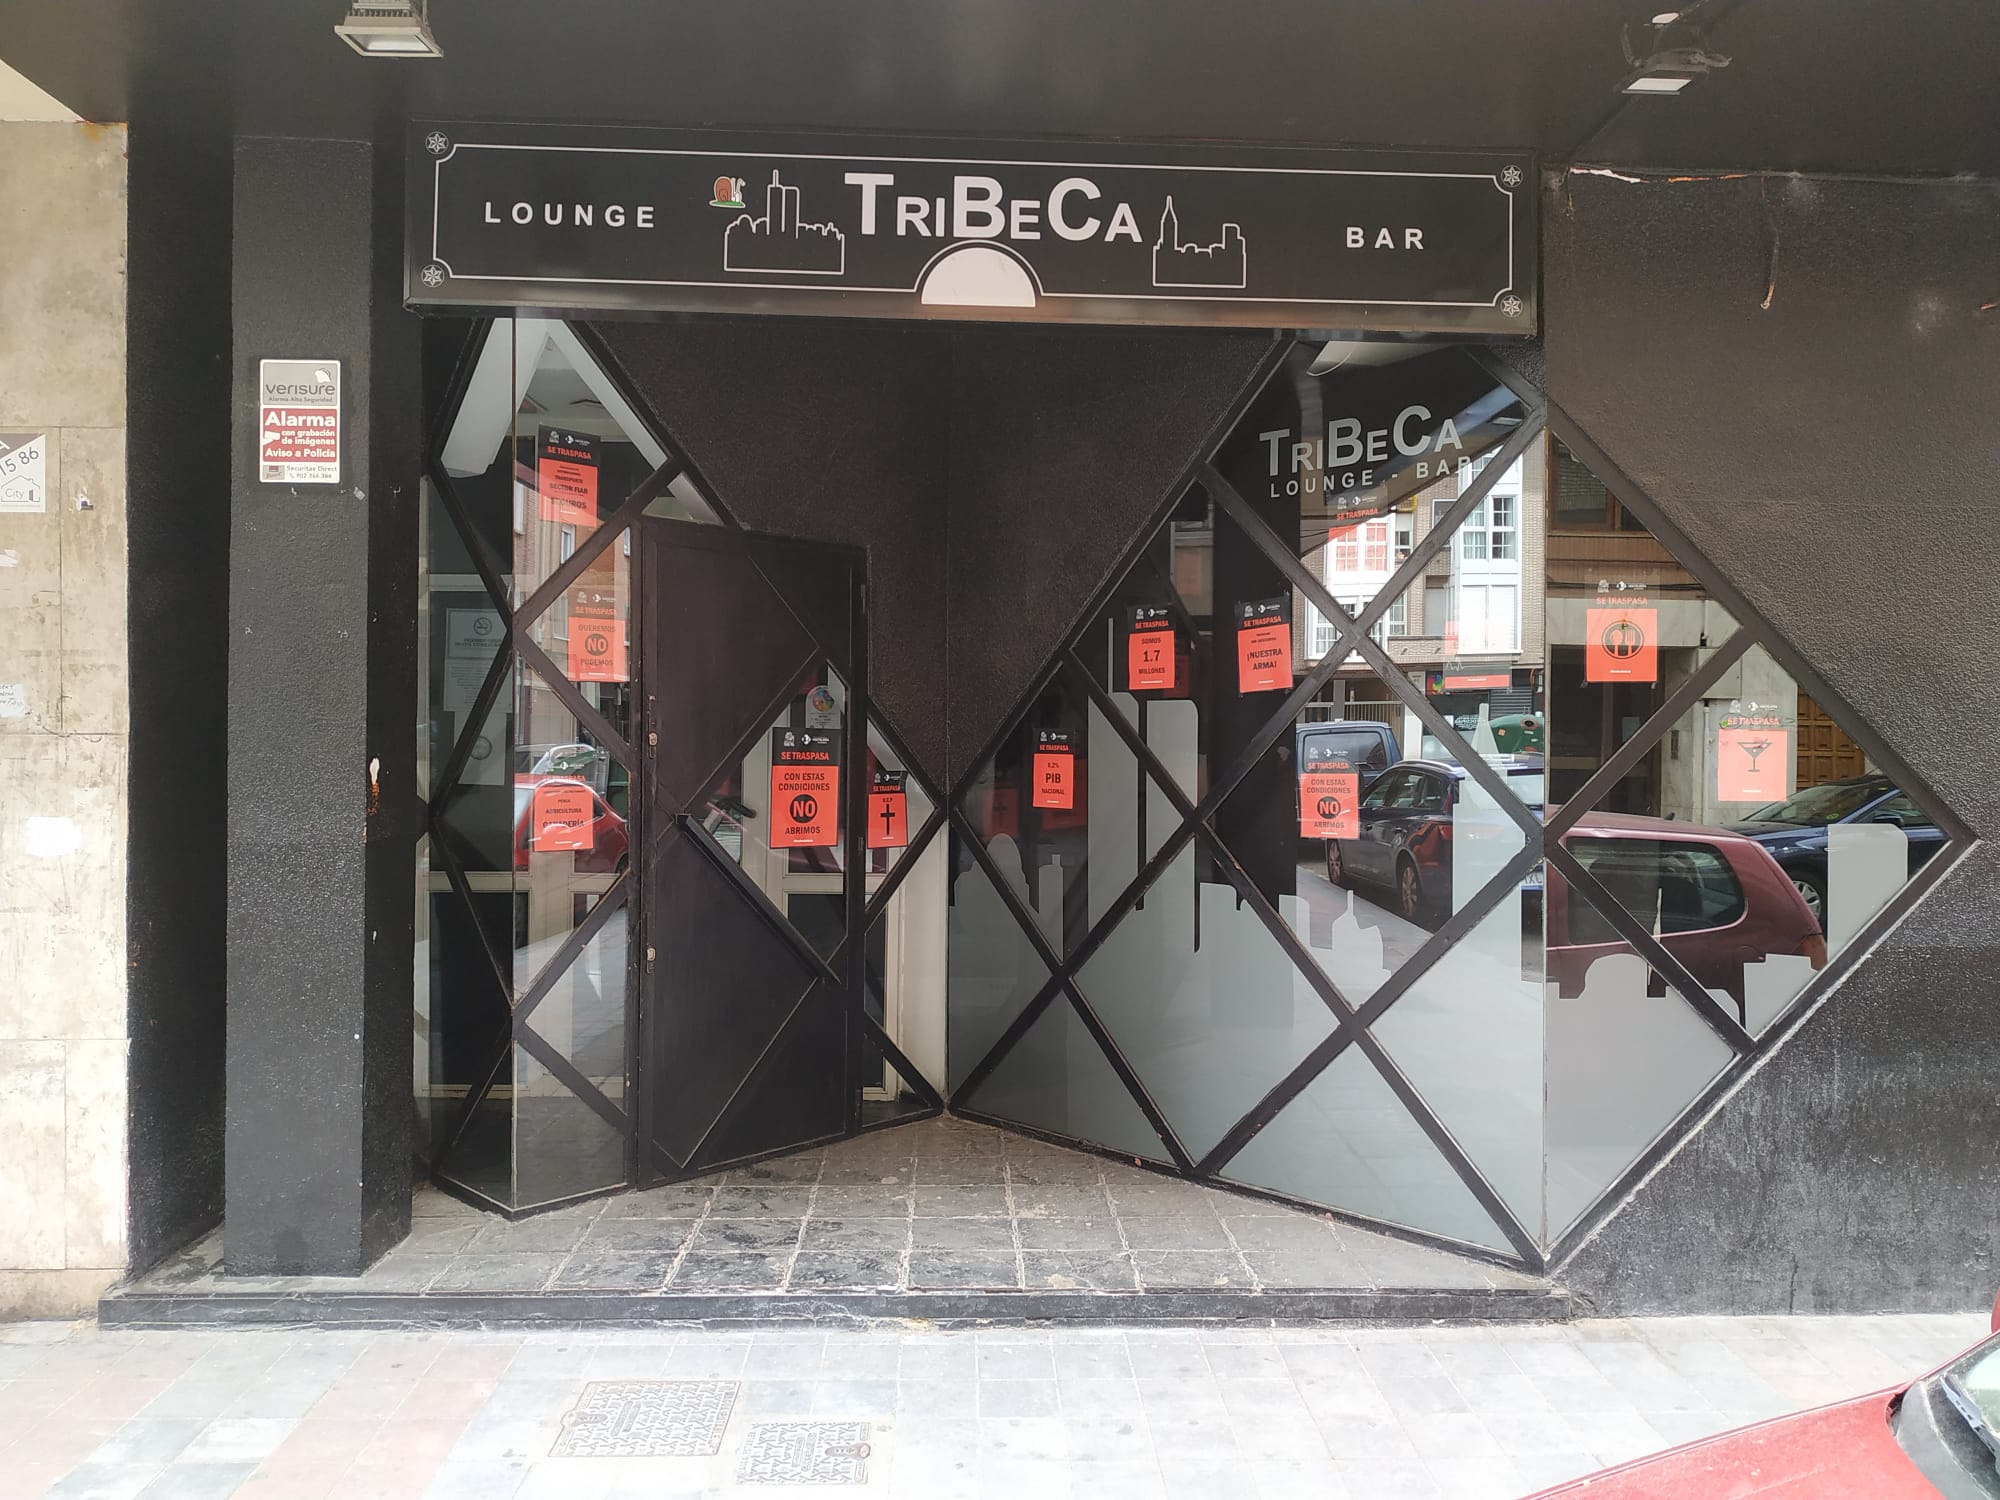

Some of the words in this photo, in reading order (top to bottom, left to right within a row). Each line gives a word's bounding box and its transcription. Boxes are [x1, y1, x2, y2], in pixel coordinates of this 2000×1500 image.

[484, 201, 655, 229] LOUNGE
[1346, 226, 1425, 250] BAR
[265, 384, 336, 396] verisure
[265, 411, 336, 427] Alarma
[297, 429, 336, 438] grabación
[281, 437, 294, 445] de
[295, 437, 336, 447] imágenes
[18, 446, 40, 465] 86
[265, 448, 293, 457] Aviso
[303, 448, 336, 458] Policía
[1270, 469, 1374, 499] LOUNGE
[5, 488, 25, 498] City
[1347, 508, 1380, 519] TRASPASA
[1596, 596, 1607, 605] SE
[1607, 596, 1648, 605] TRASPASA
[578, 624, 616, 633] QUEREMOS
[586, 638, 608, 652] NO
[1143, 650, 1161, 663] 1.7
[580, 658, 614, 667] PODEMOS
[1739, 717, 1780, 725] TRASPASA
[781, 752, 791, 760] SE
[792, 752, 830, 761] TRASPASA
[784, 773, 800, 781] CON
[802, 773, 825, 781] ESTAS
[1045, 773, 1062, 784] PIB
[778, 783, 830, 791] CONDICIONES
[793, 800, 816, 817] NO
[1319, 801, 1339, 815] NO
[785, 826, 821, 835] ABRIMOS
